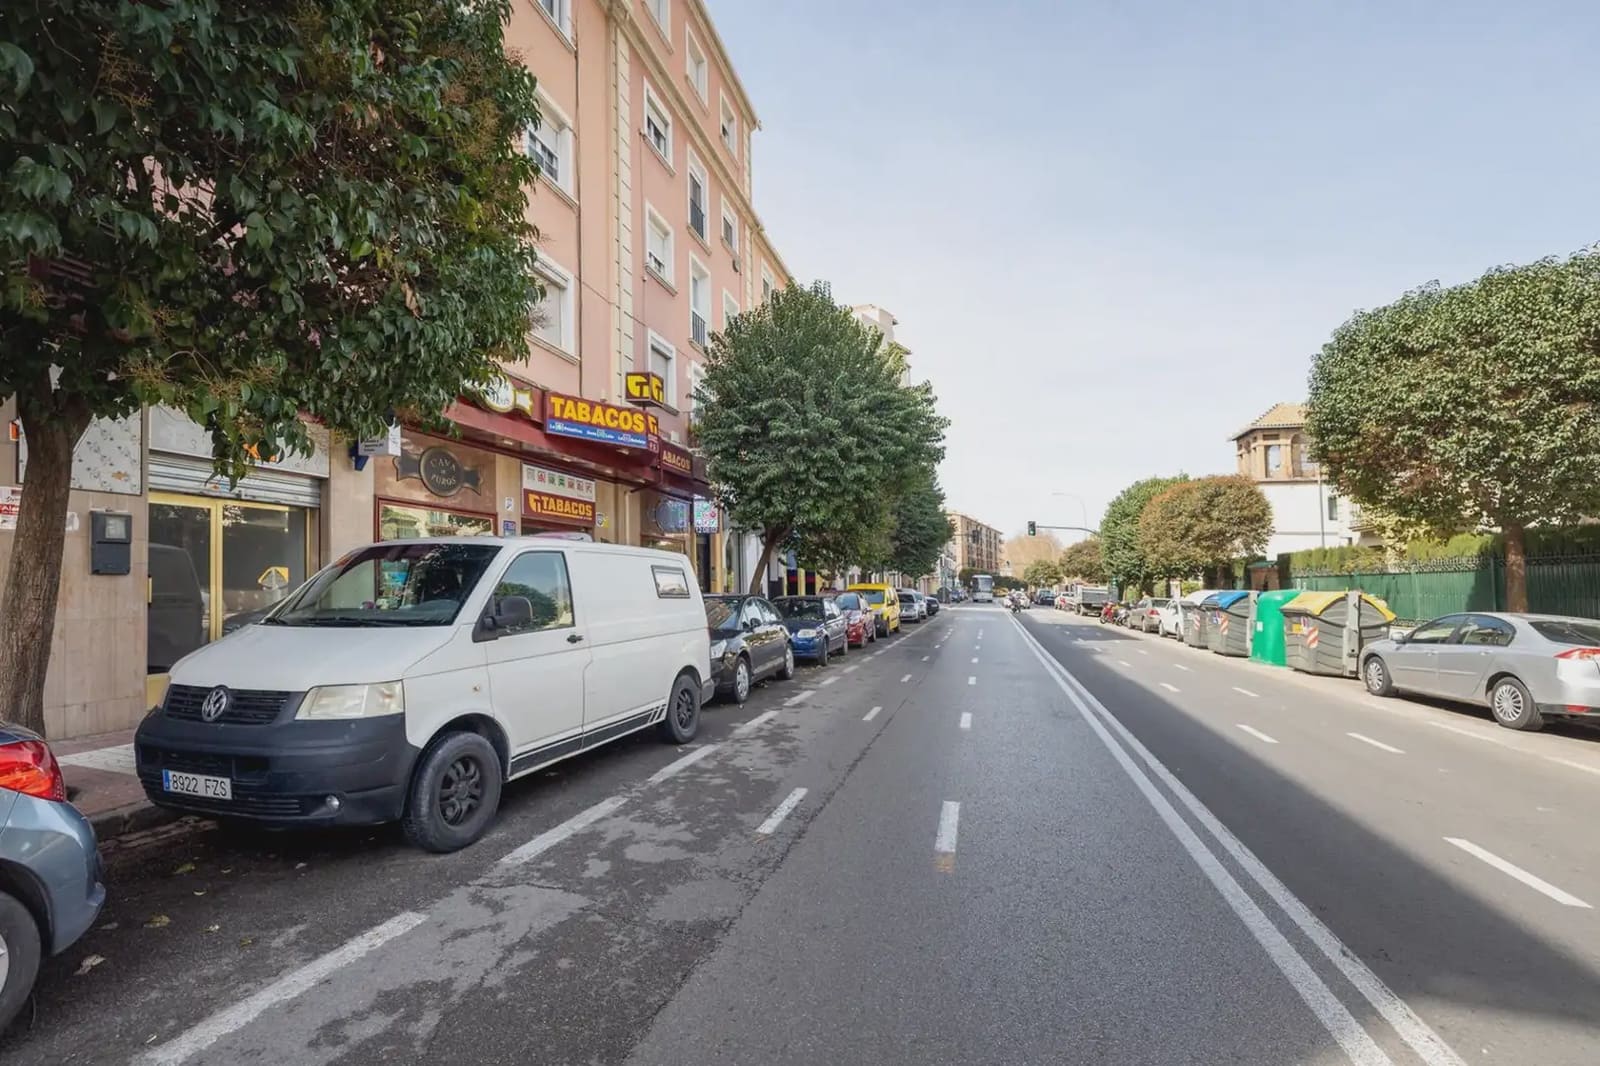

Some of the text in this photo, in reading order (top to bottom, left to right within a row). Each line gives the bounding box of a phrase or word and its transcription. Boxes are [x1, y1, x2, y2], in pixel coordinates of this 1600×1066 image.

[550, 397, 646, 433] TABACOS
[662, 450, 691, 470] ABACOS
[430, 474, 456, 487] PUROS
[541, 496, 593, 517] TABACOS
[171, 774, 228, 797] 8922 FZS
